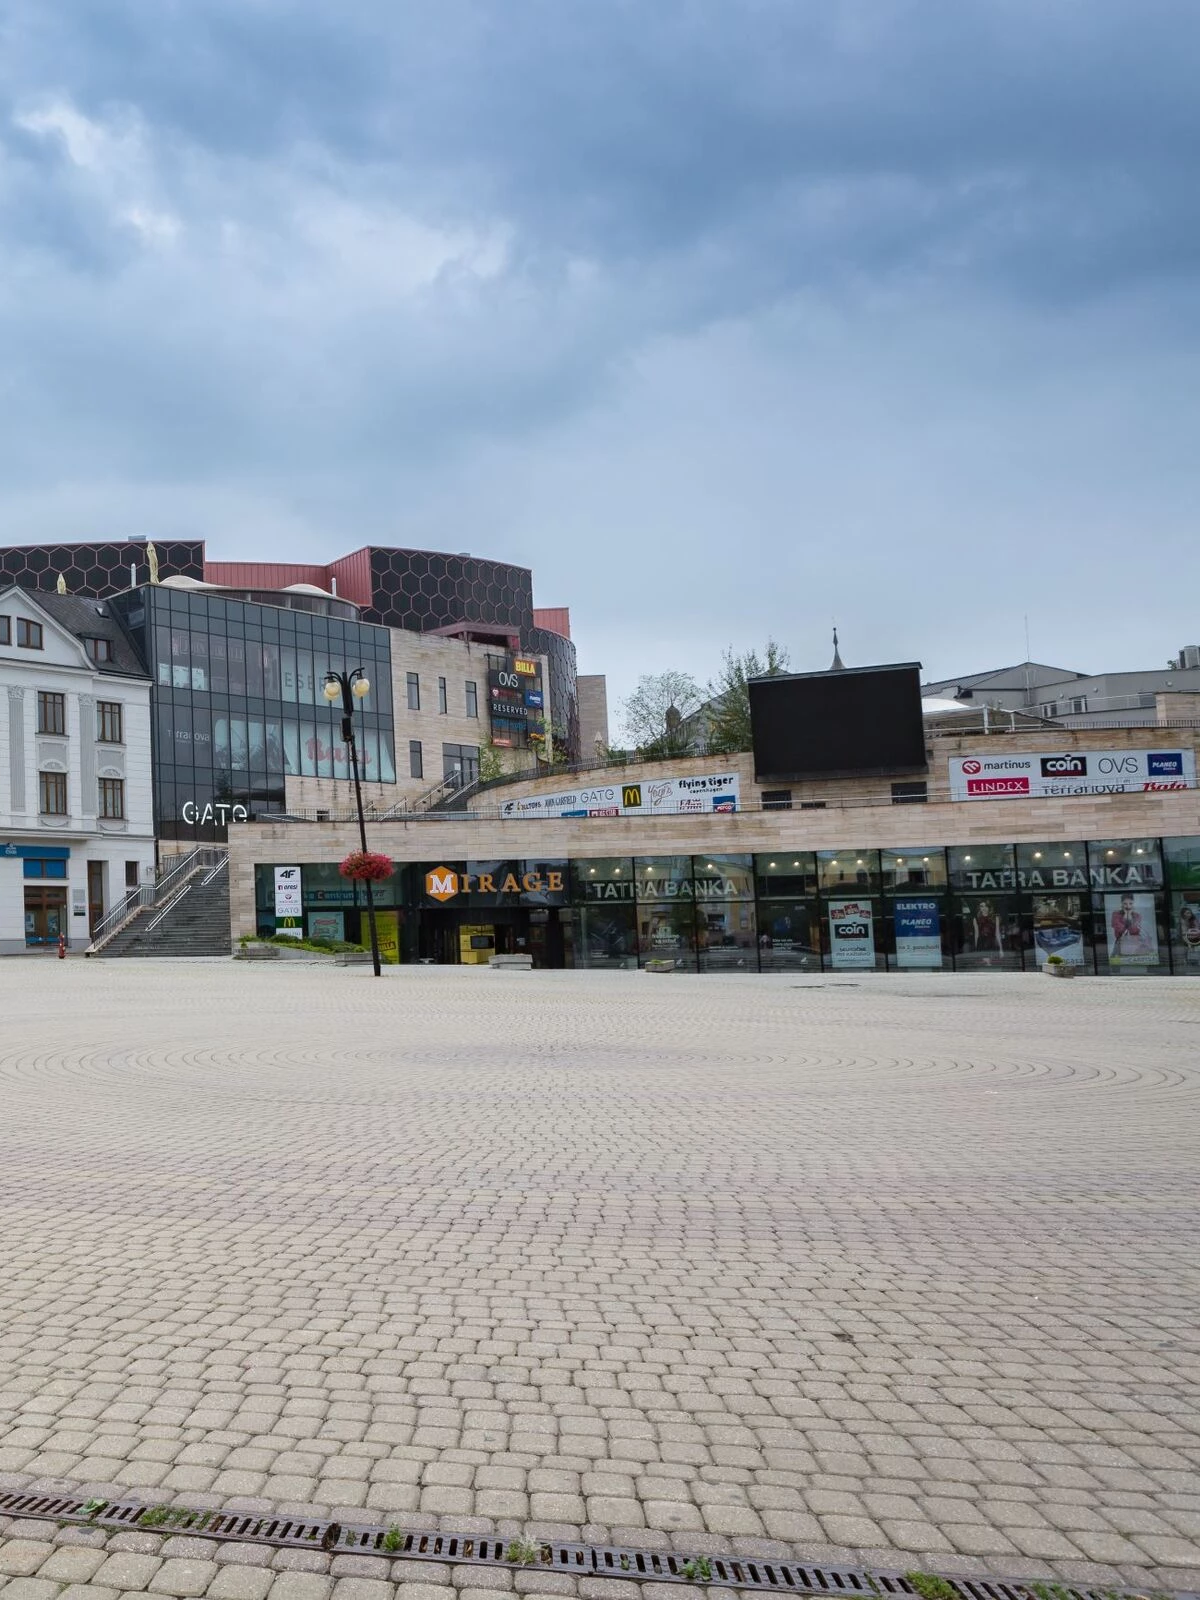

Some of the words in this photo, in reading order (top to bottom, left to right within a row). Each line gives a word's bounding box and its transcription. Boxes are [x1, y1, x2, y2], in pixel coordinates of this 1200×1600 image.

[515, 662, 535, 675] BILLA
[498, 672, 519, 687] OVS
[493, 703, 528, 716] RESERVED
[984, 760, 1031, 770] martinus
[1046, 755, 1082, 772] coin
[1098, 758, 1138, 774] OVS
[679, 779, 707, 789] flying
[708, 777, 734, 787] tiger
[972, 781, 1024, 792] LINDEX
[429, 871, 564, 894] MIRAGE
[967, 869, 1045, 889] TATRA
[1053, 866, 1143, 887] BANKA
[592, 881, 658, 898] TATRA
[664, 878, 738, 897] BANKA
[896, 903, 936, 911] ELEKTRO
[838, 923, 865, 935] coin
